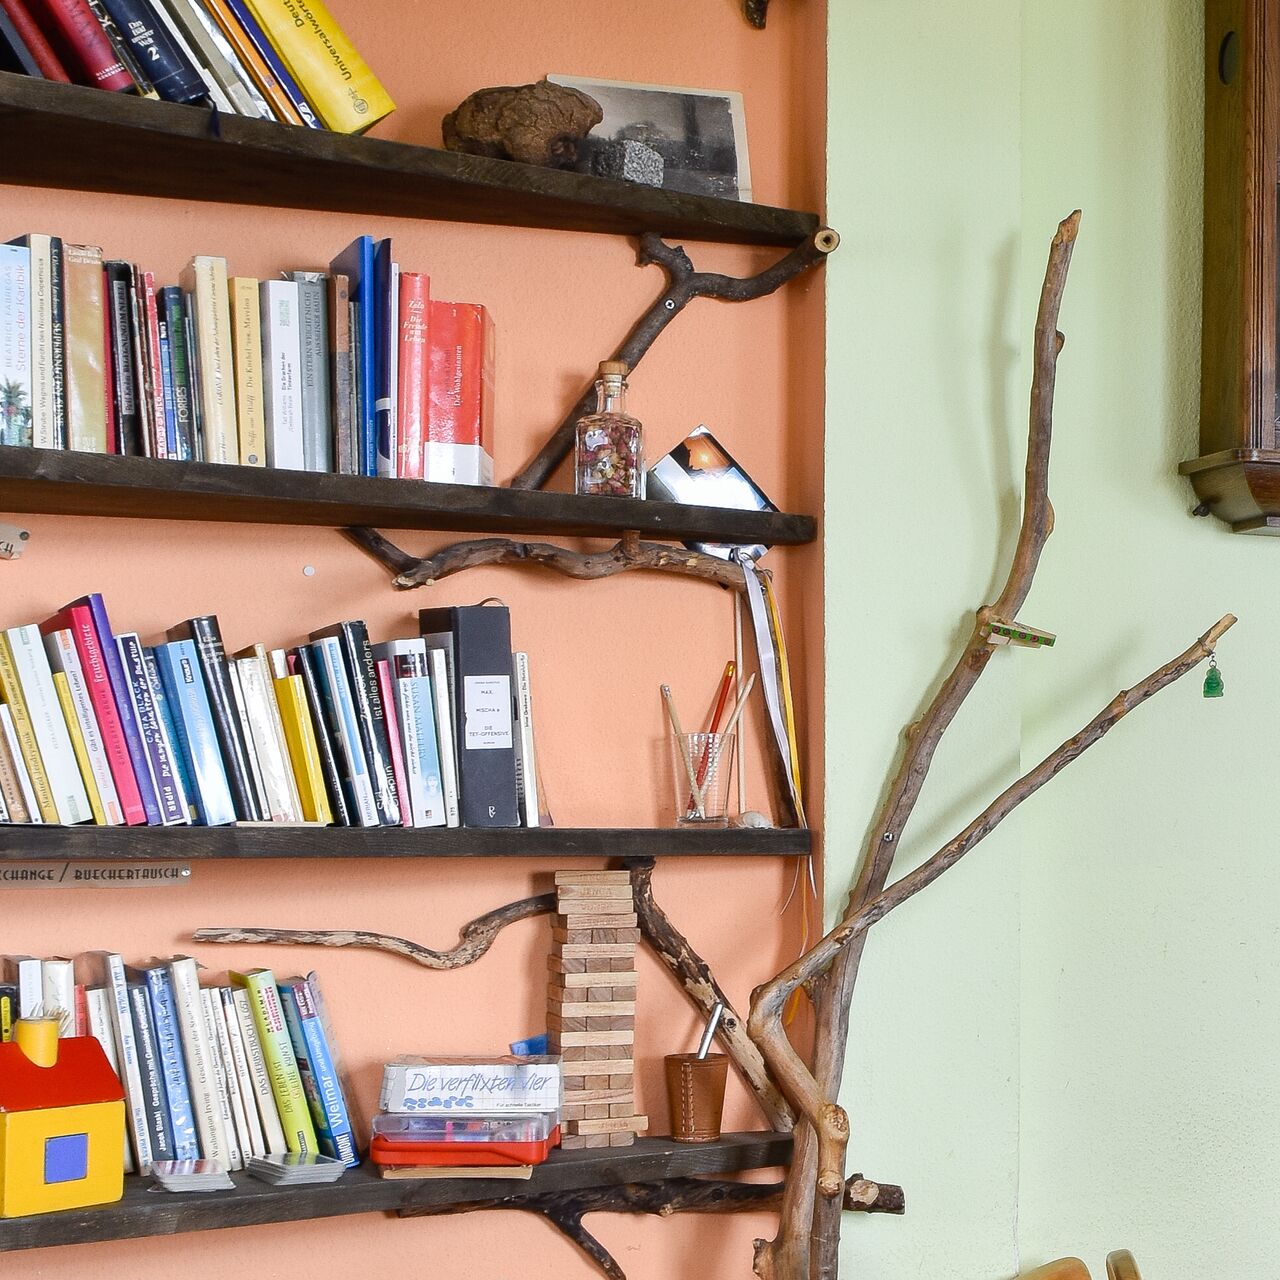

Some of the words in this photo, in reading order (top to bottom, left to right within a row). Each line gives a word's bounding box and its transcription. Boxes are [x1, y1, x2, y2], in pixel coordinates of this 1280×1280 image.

[359, 639, 374, 679] anders
[161, 785, 175, 811] PIPER
[0, 870, 54, 880] CHANGE
[75, 868, 178, 880] BUECHERTAUSCH
[244, 1023, 263, 1077] HERBSTBUCH
[277, 1041, 292, 1067] KUNST
[257, 1078, 267, 1095] DAS
[274, 1073, 288, 1098] LEBEN
[407, 1073, 438, 1092] Die
[440, 1073, 515, 1096] verflixten
[280, 1099, 292, 1113] DAS
[318, 1073, 342, 1127] Weimar
[203, 1115, 220, 1158] Washington
